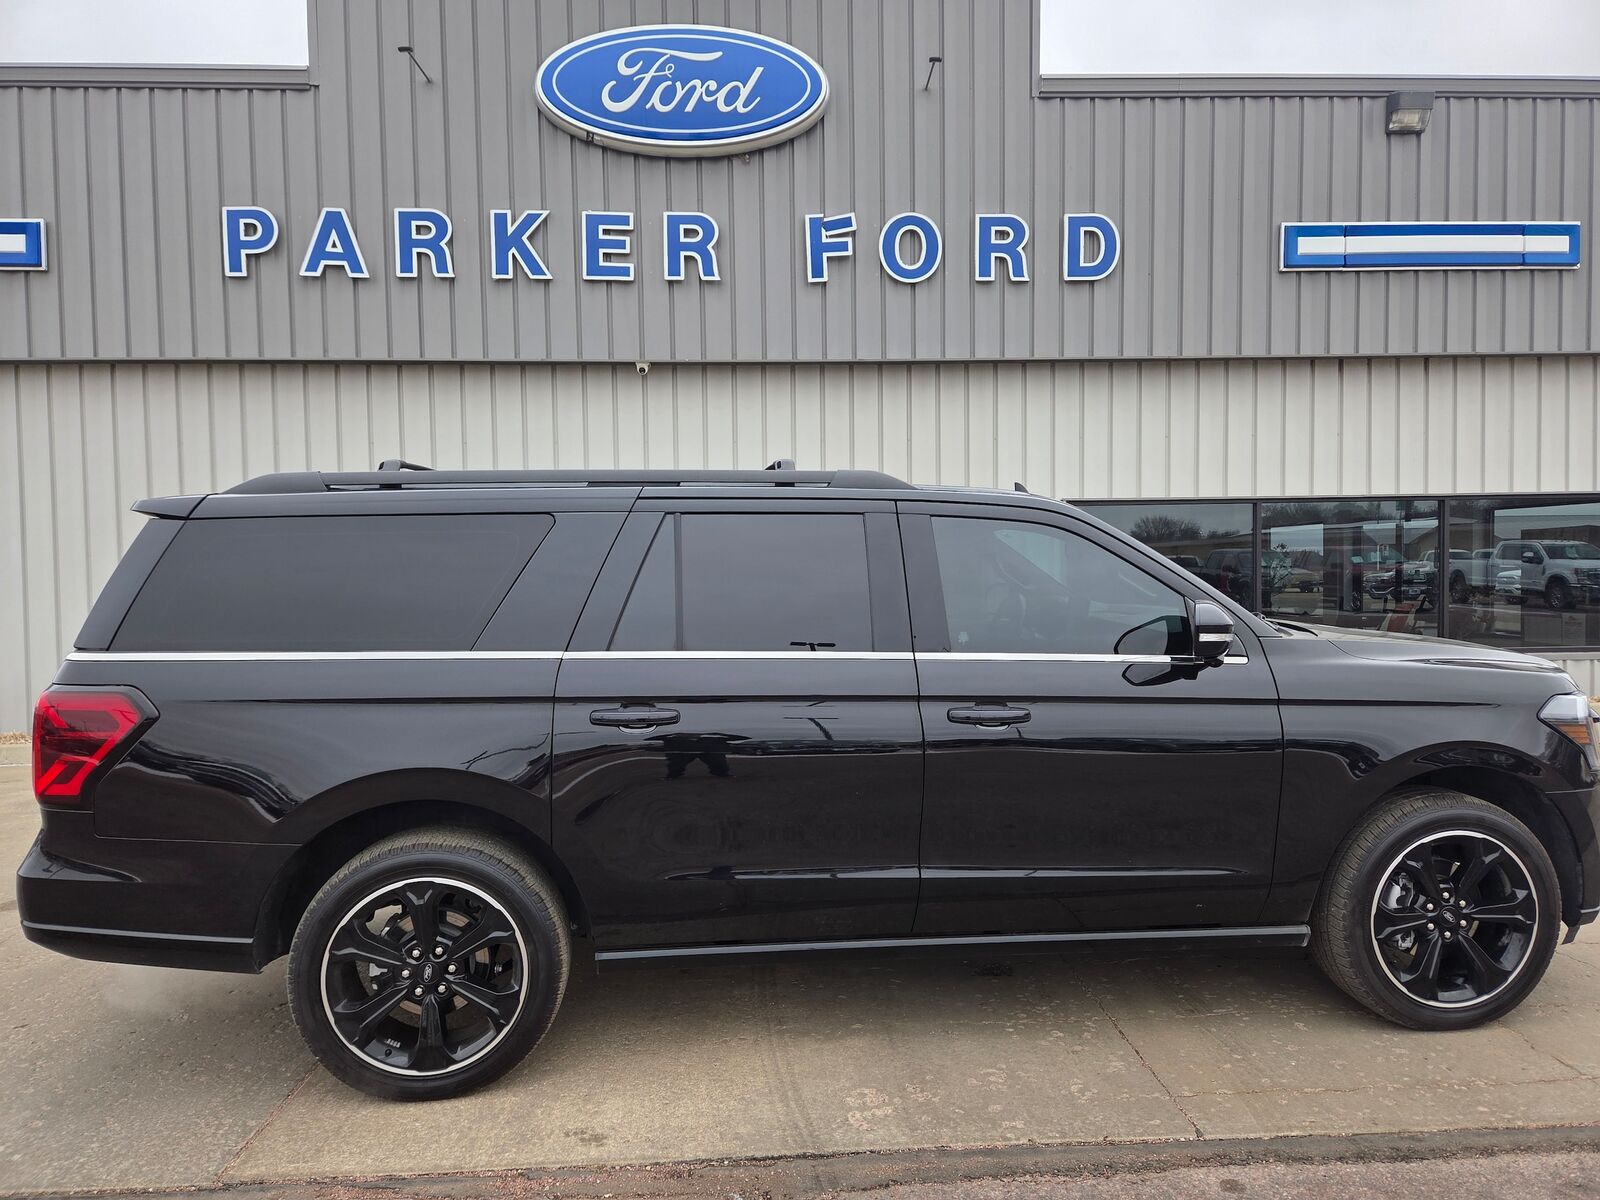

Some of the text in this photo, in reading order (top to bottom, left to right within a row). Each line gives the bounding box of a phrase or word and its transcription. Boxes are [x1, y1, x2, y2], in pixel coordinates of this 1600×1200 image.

[601, 47, 764, 113] Ford
[222, 206, 1121, 283] PARKER FORD
